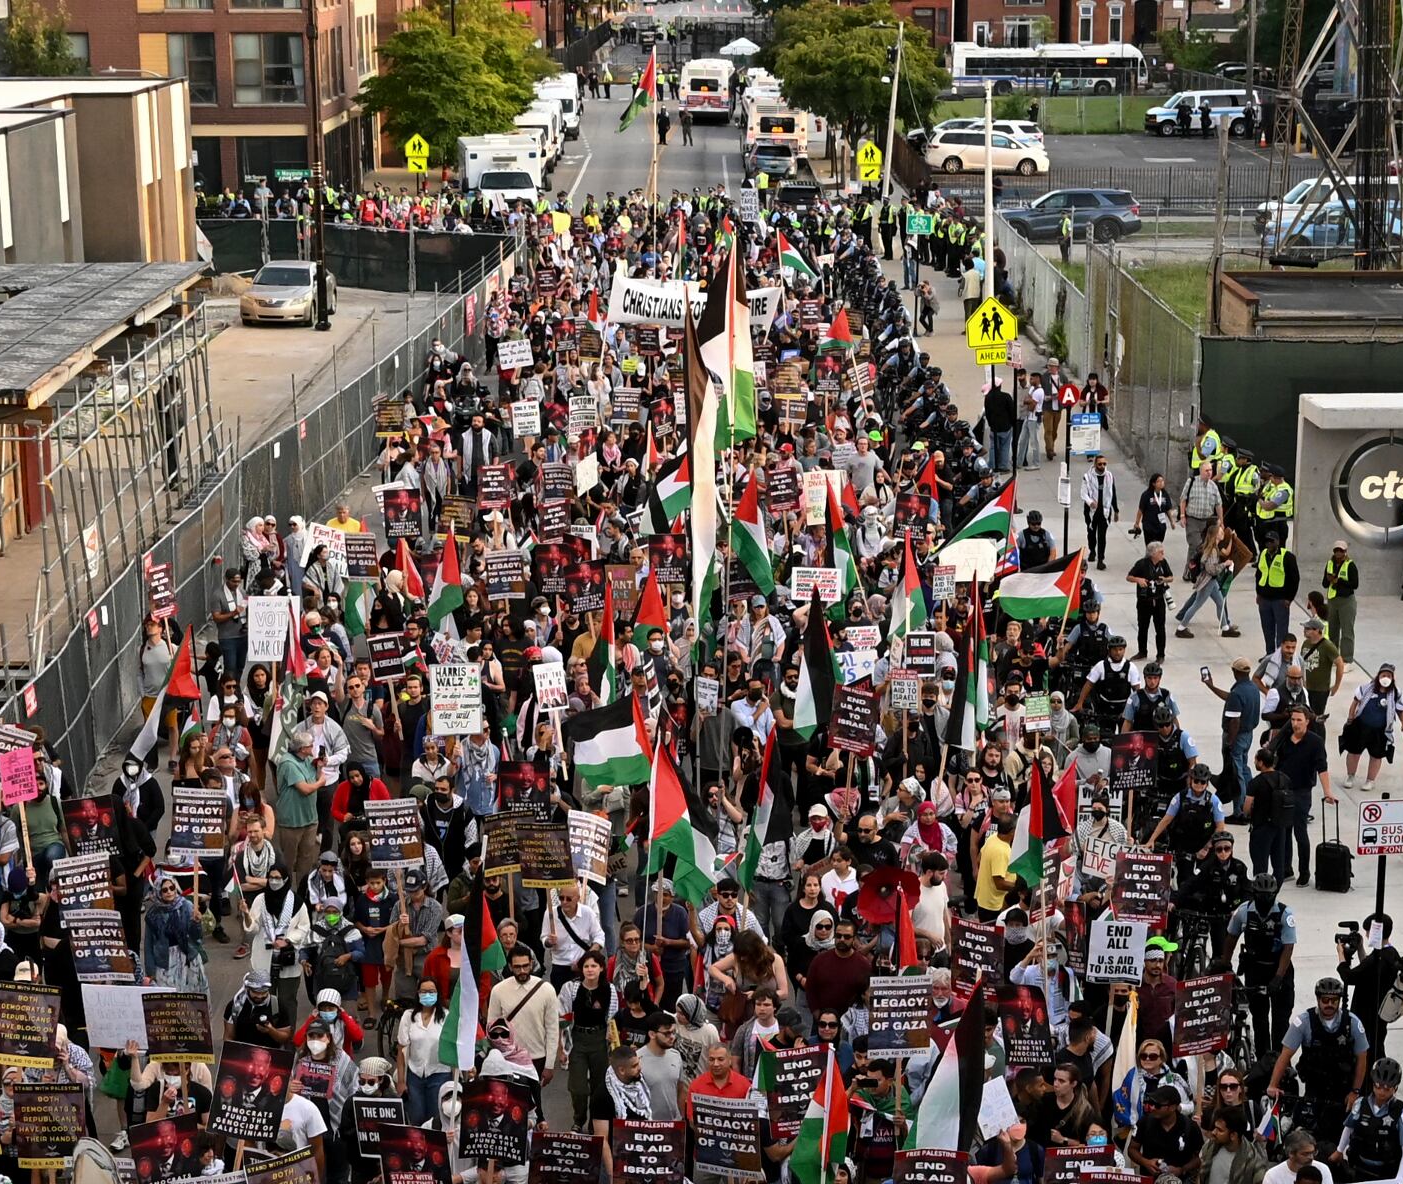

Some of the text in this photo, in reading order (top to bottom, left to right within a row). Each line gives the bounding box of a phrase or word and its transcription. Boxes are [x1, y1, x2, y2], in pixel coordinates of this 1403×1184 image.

[623, 288, 682, 320] CHRISTIANS
[980, 352, 1006, 361] AHEAD
[435, 668, 467, 676] HARRIS
[437, 677, 463, 686] WALZ
[175, 806, 223, 815] LEGACY:
[174, 825, 221, 834] OF GAZA
[1381, 826, 1403, 835] BUS
[1086, 838, 1108, 853] LET
[1084, 852, 1111, 874] LIVE
[1107, 926, 1132, 937] END
[1107, 938, 1129, 949] ALL
[1090, 964, 1138, 976] TO ISRAEL
[362, 1107, 396, 1118] THE DNC
